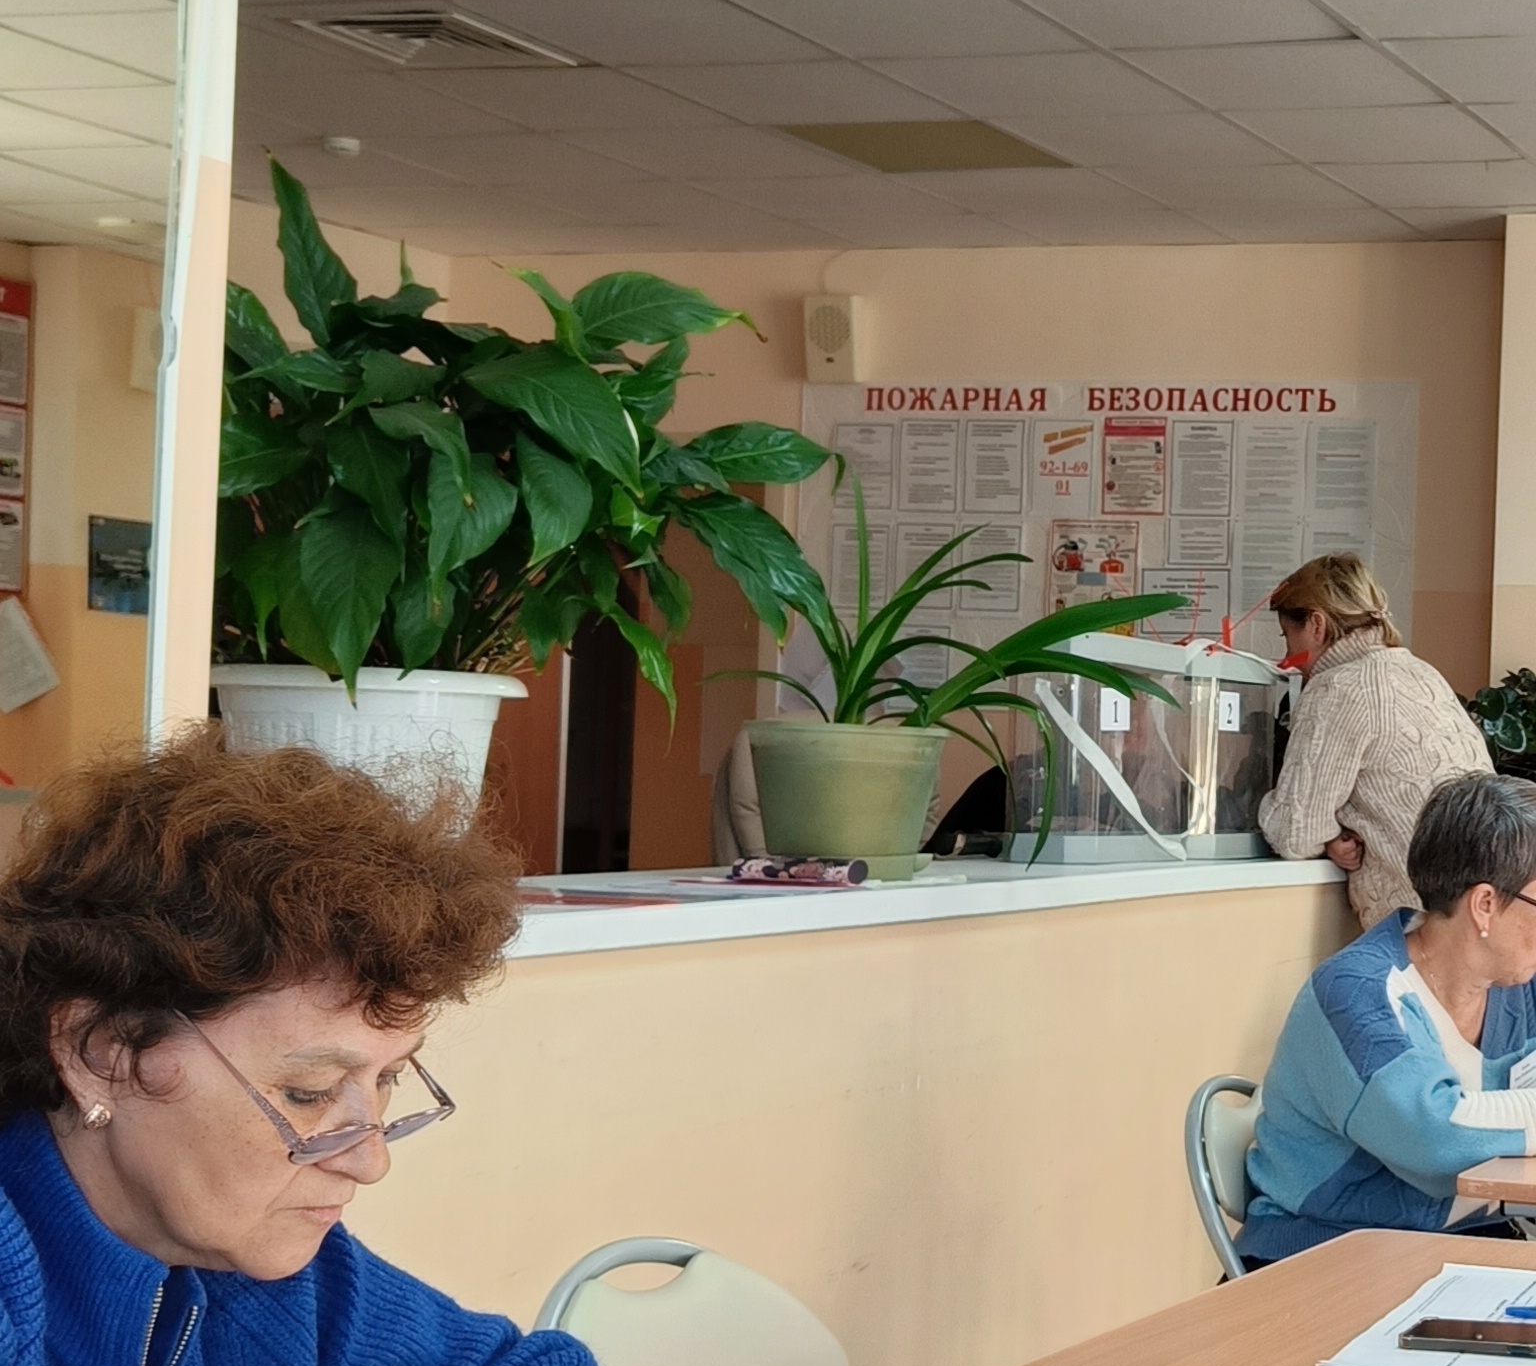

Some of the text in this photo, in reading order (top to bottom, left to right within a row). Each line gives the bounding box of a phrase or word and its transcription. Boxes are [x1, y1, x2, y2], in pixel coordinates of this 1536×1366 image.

[865, 386, 1338, 413] ПОЖАРНАЯ БЕЗОПАСНОСТЬ
[1039, 460, 1089, 474] 92-1-69
[1055, 481, 1070, 494] 01
[1110, 700, 1121, 723] 1
[1225, 702, 1234, 722] 2
